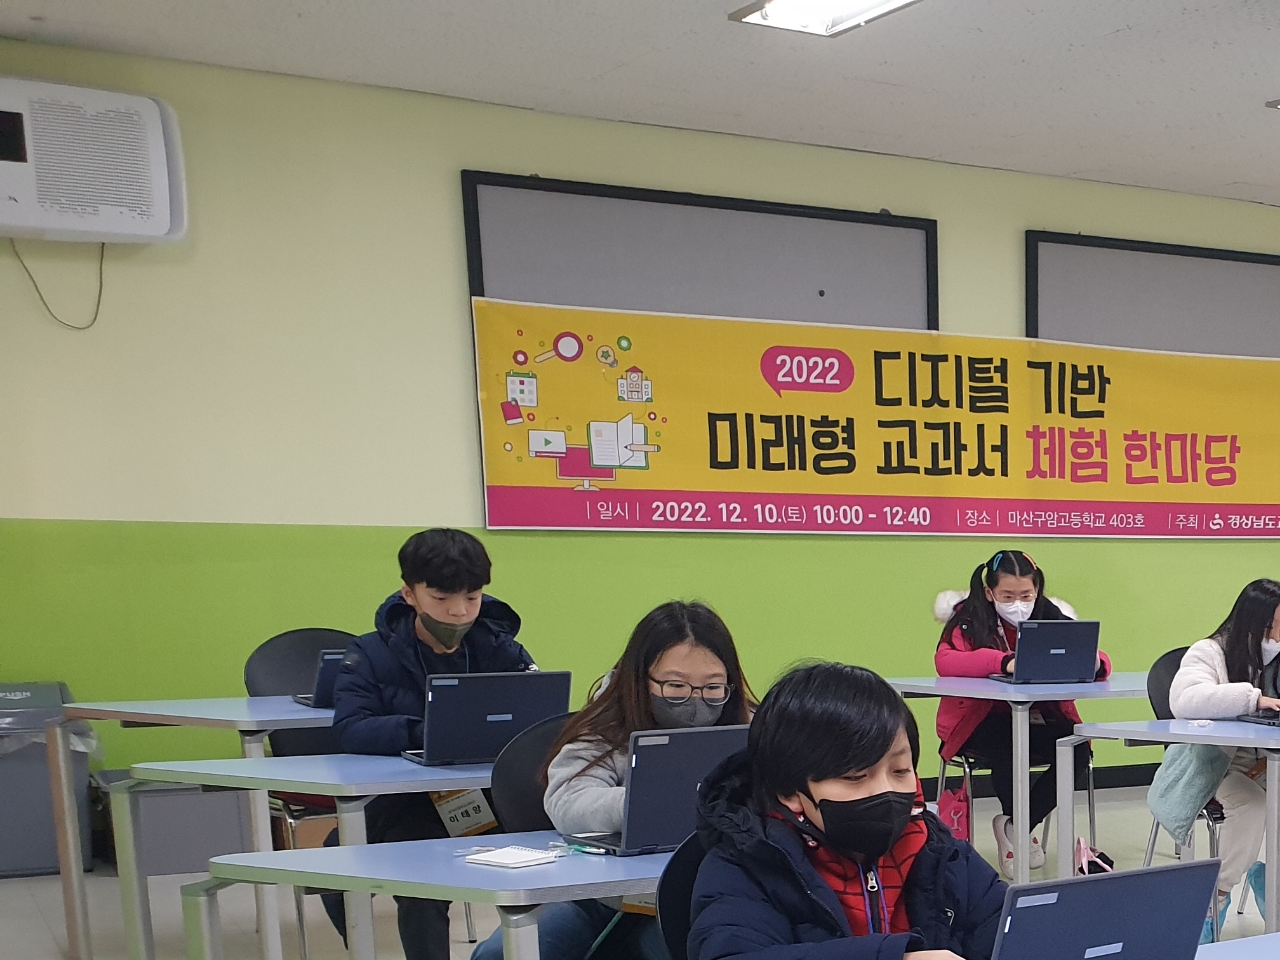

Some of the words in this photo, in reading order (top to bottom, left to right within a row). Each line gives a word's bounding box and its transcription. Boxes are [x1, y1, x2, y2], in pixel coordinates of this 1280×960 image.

[776, 354, 841, 385] 2022
[873, 350, 1010, 414] 디지털
[1026, 360, 1111, 419] 기반
[707, 411, 857, 476] 미래형
[876, 419, 1009, 477] 교과서
[1025, 424, 1108, 483] 체험
[1123, 429, 1241, 487] 한마당
[597, 501, 629, 520] 일시
[651, 501, 712, 522] 2022.
[718, 503, 748, 523] 12.
[813, 504, 864, 525] 10:00
[883, 506, 931, 526] 12:40
[965, 509, 992, 527] 장소
[1008, 511, 1107, 529] 마산구암고등학교
[1109, 513, 1146, 529] 403호
[1175, 514, 1199, 530] 주최
